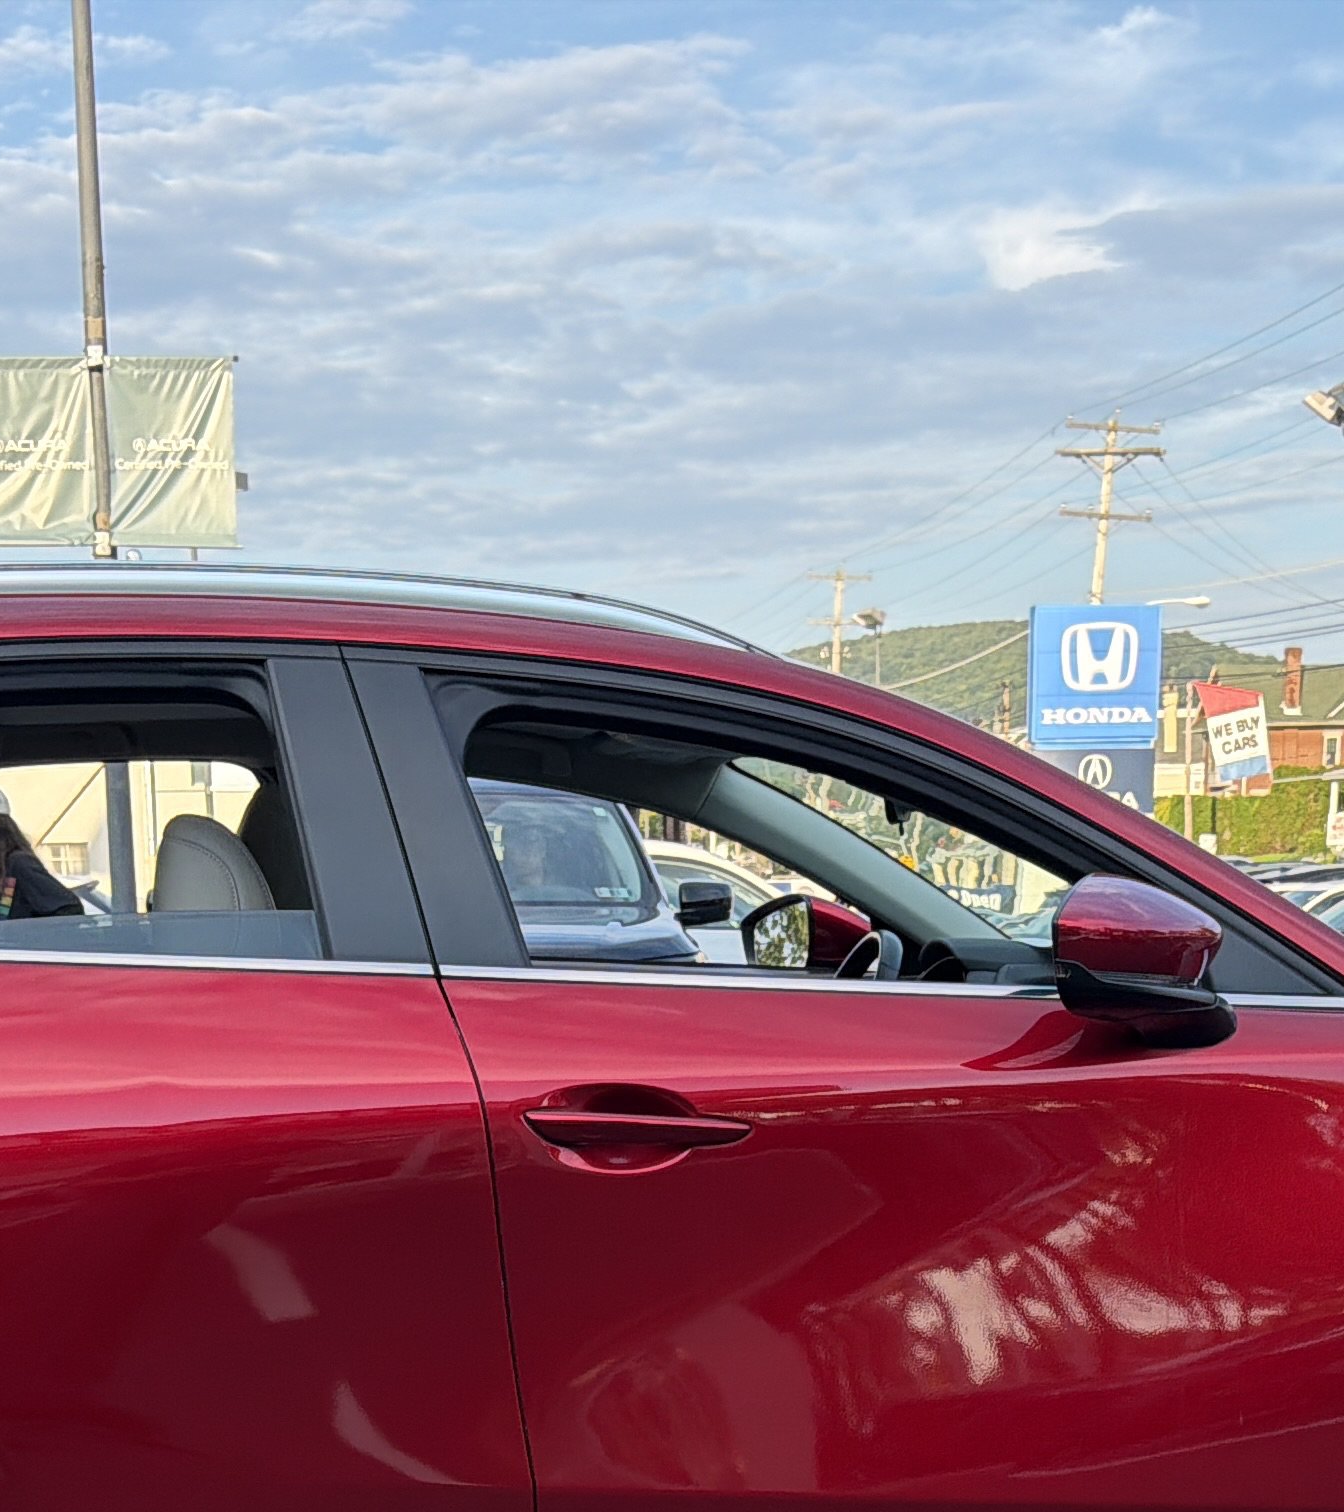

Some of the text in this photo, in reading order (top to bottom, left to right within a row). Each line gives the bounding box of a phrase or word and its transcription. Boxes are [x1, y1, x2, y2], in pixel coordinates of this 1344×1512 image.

[4, 439, 70, 453] ACURA
[147, 438, 211, 452] ACURA
[1040, 707, 1154, 725] HONDA
[1211, 715, 1261, 739] WE BUY
[1221, 733, 1259, 755] CARS
